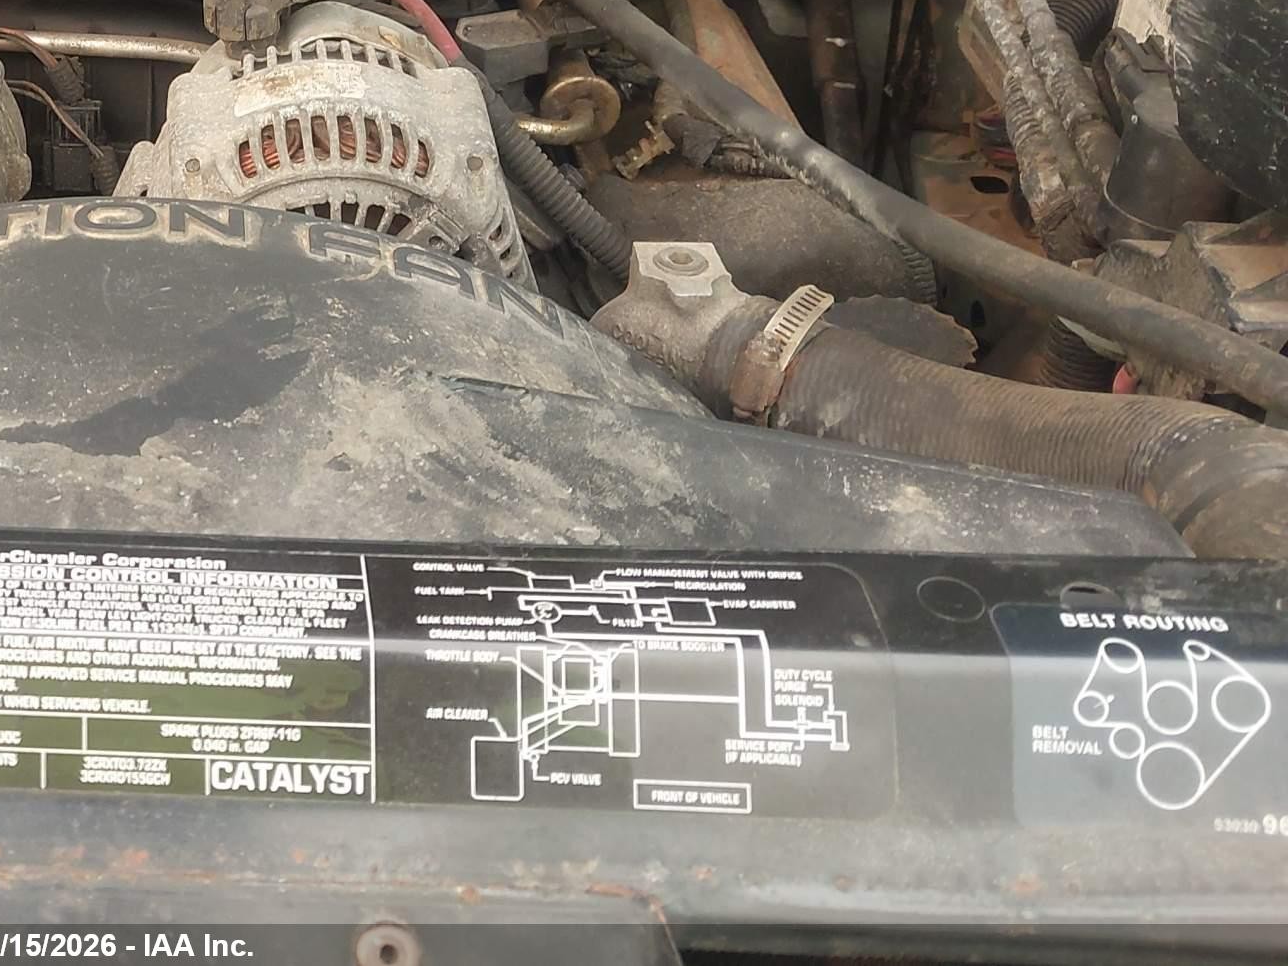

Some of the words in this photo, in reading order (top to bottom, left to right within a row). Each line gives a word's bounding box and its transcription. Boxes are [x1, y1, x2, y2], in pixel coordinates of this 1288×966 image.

[305, 220, 568, 341] FAN
[103, 553, 226, 570] Corporation
[71, 566, 174, 584] CONTROL
[180, 571, 338, 589] INFORMATION
[1060, 612, 1116, 629] BELT
[1123, 614, 1229, 632] ROUTING
[1032, 725, 1069, 739] BELT
[1032, 740, 1102, 755] REMOVAL
[211, 761, 370, 795] CATALYST
